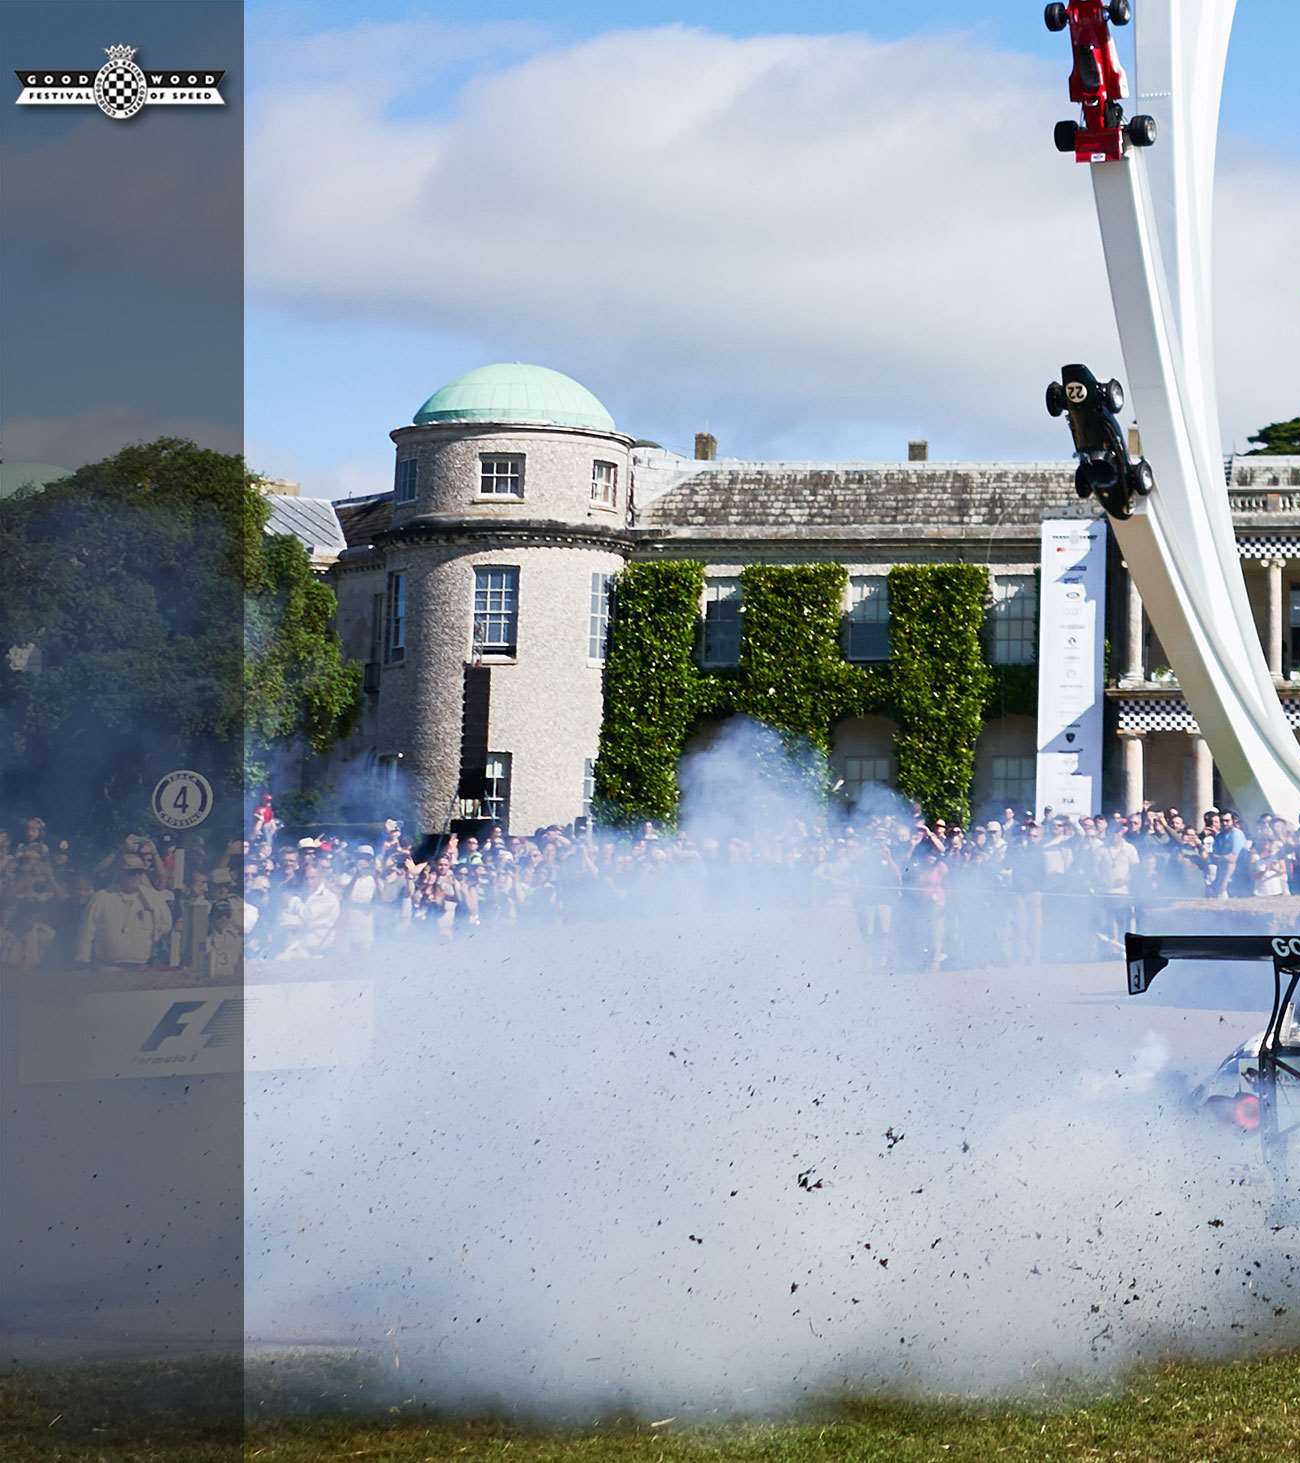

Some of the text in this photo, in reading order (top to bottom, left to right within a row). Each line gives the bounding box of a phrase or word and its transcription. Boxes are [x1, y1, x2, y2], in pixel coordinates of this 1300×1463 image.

[1067, 385, 1085, 400] 22
[173, 786, 189, 814] 4
[128, 1053, 188, 1065] Formula
